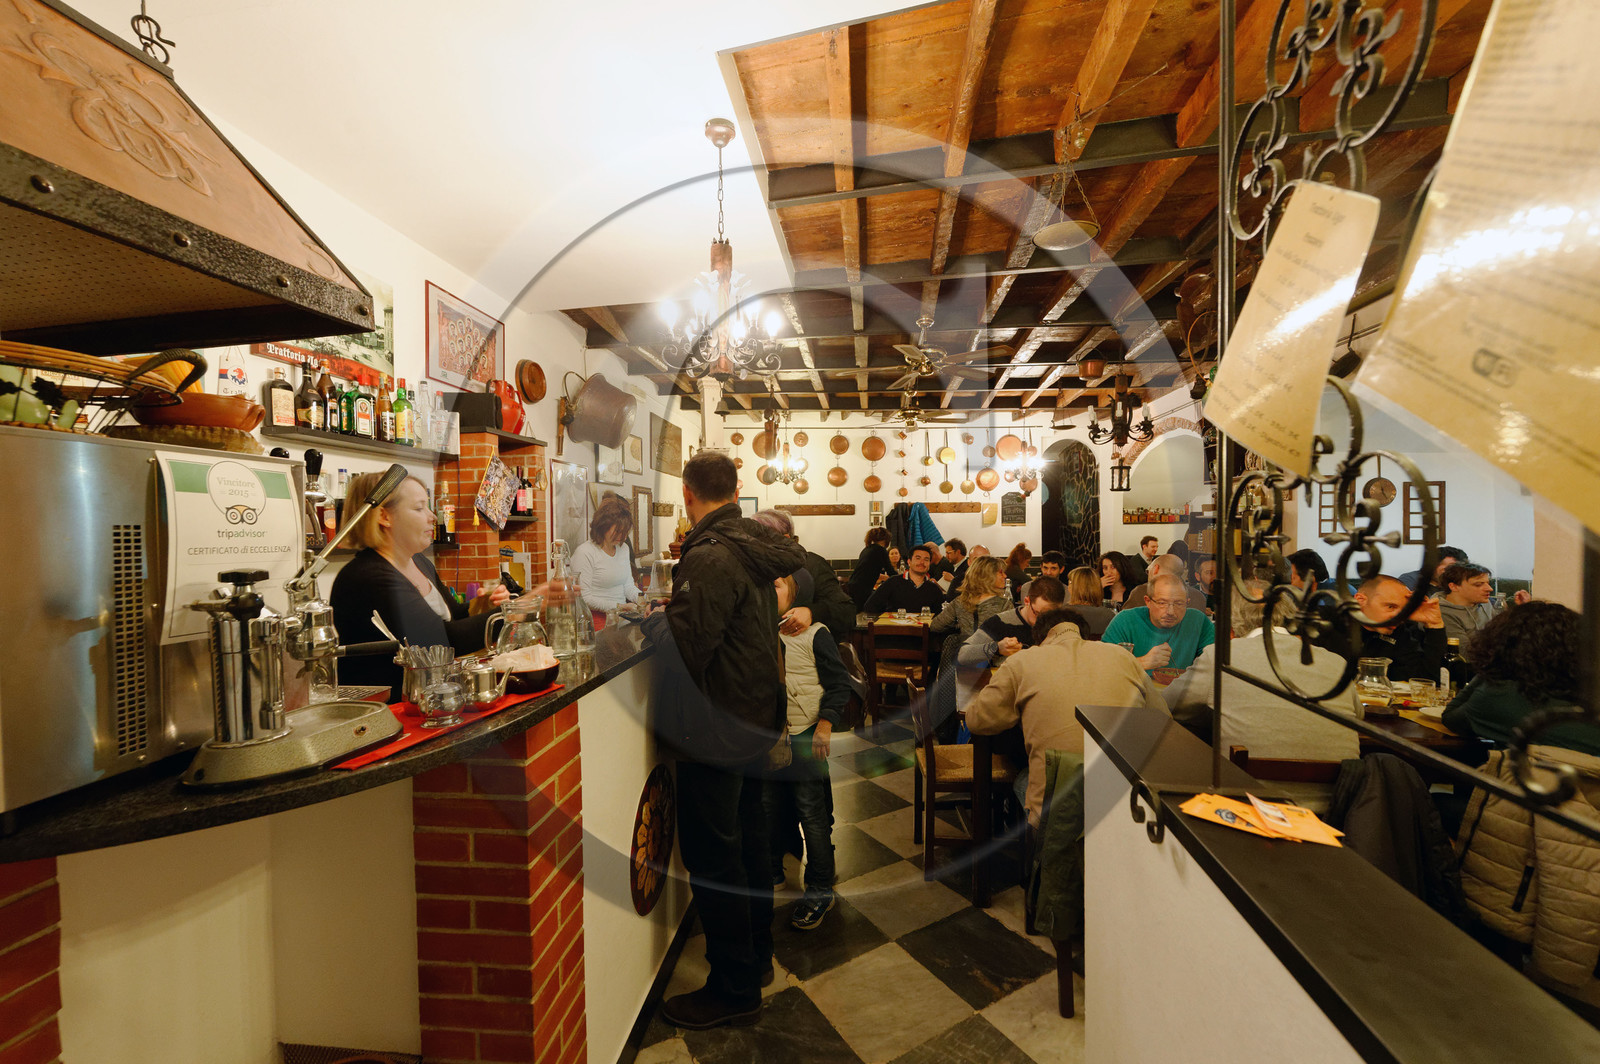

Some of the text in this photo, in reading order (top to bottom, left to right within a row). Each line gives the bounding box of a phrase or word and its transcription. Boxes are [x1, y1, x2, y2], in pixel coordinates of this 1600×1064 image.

[266, 342, 305, 362] Trattoria
[216, 476, 255, 489] Vincitore
[228, 489, 249, 498] 2015
[217, 529, 265, 540] tripadvisor
[187, 545, 291, 556] CERTIFICATO di ECCELLENZA
